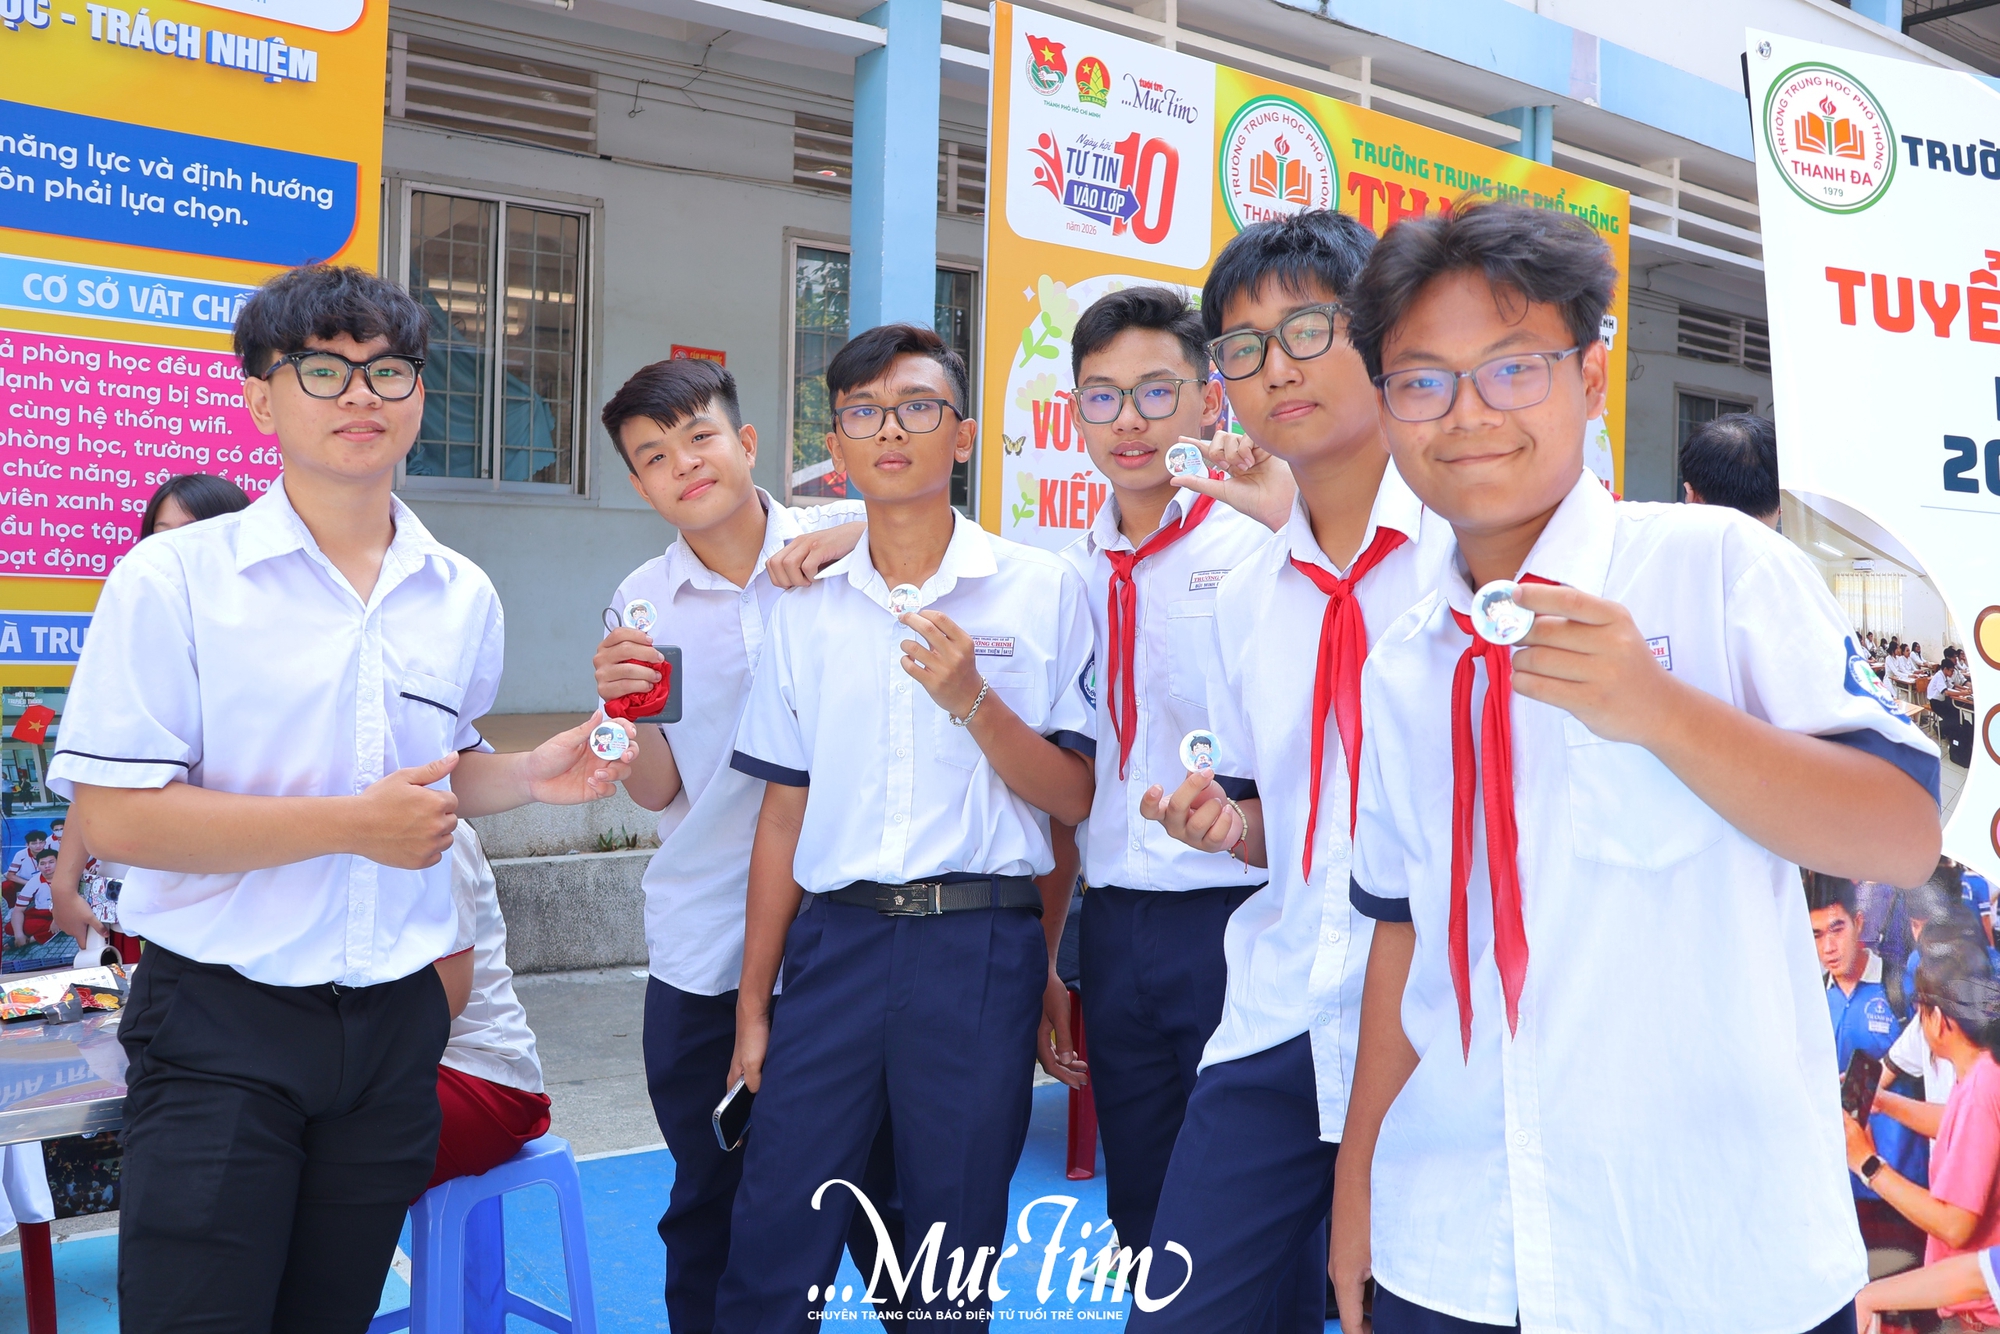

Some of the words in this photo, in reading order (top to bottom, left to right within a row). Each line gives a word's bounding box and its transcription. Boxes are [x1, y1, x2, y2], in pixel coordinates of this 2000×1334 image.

[86, 2, 201, 60] TRÁCH
[206, 30, 318, 83] NHIỆM
[1774, 98, 1789, 155] TRƯỜNG
[1784, 76, 1822, 98] TRUNG
[1825, 78, 1851, 96] HỌC
[1872, 122, 1885, 171] THÔNG
[1076, 133, 1098, 150] Ngày
[1230, 134, 1247, 198] TRƯỜNG
[1243, 111, 1280, 135] TRUNG
[1282, 113, 1306, 135] HỌC
[0, 132, 78, 170] năng
[88, 143, 131, 176] lực
[138, 153, 174, 180] và
[182, 162, 243, 192] định
[251, 172, 334, 210] hướng
[1066, 147, 1090, 179] TỰ
[1092, 153, 1120, 183] TIN
[1791, 159, 1846, 183] THANH
[1850, 169, 1873, 187] ĐA
[45, 176, 112, 206] phải
[121, 185, 165, 216] lựa
[173, 195, 249, 228] chọn.
[1073, 184, 1099, 209] VÀO
[1100, 190, 1126, 214] LỚP
[1112, 131, 1179, 245] 10
[1351, 137, 1429, 180] TRƯỜNG
[1433, 162, 1492, 198] TRUNG
[1568, 203, 1620, 235] THÔNG
[1823, 186, 1844, 198] 1979
[1066, 221, 1080, 232] năm
[1081, 223, 1097, 236] 2026
[22, 272, 68, 304] CƠ
[77, 275, 120, 310] SỞ
[129, 283, 184, 319] VẬT
[22, 342, 101, 372] phòng
[108, 349, 152, 376] học
[157, 355, 201, 377] đều
[0, 366, 53, 393] lạnh
[60, 375, 91, 394] và
[97, 379, 161, 406] trang
[168, 383, 189, 409] bị
[9, 400, 70, 427] cùng
[78, 404, 108, 430] hệ
[114, 408, 182, 436] thống
[189, 415, 233, 435] wifi.
[78, 433, 127, 459] học,
[134, 439, 210, 465] trường
[216, 445, 243, 463] có
[3, 458, 63, 480] chức
[70, 462, 137, 488] năng,
[0, 487, 48, 508] viên
[56, 492, 114, 511] xanh
[1, 514, 33, 536] ầu
[40, 518, 85, 543] học
[91, 521, 139, 545] tập,
[43, 547, 107, 573] động
